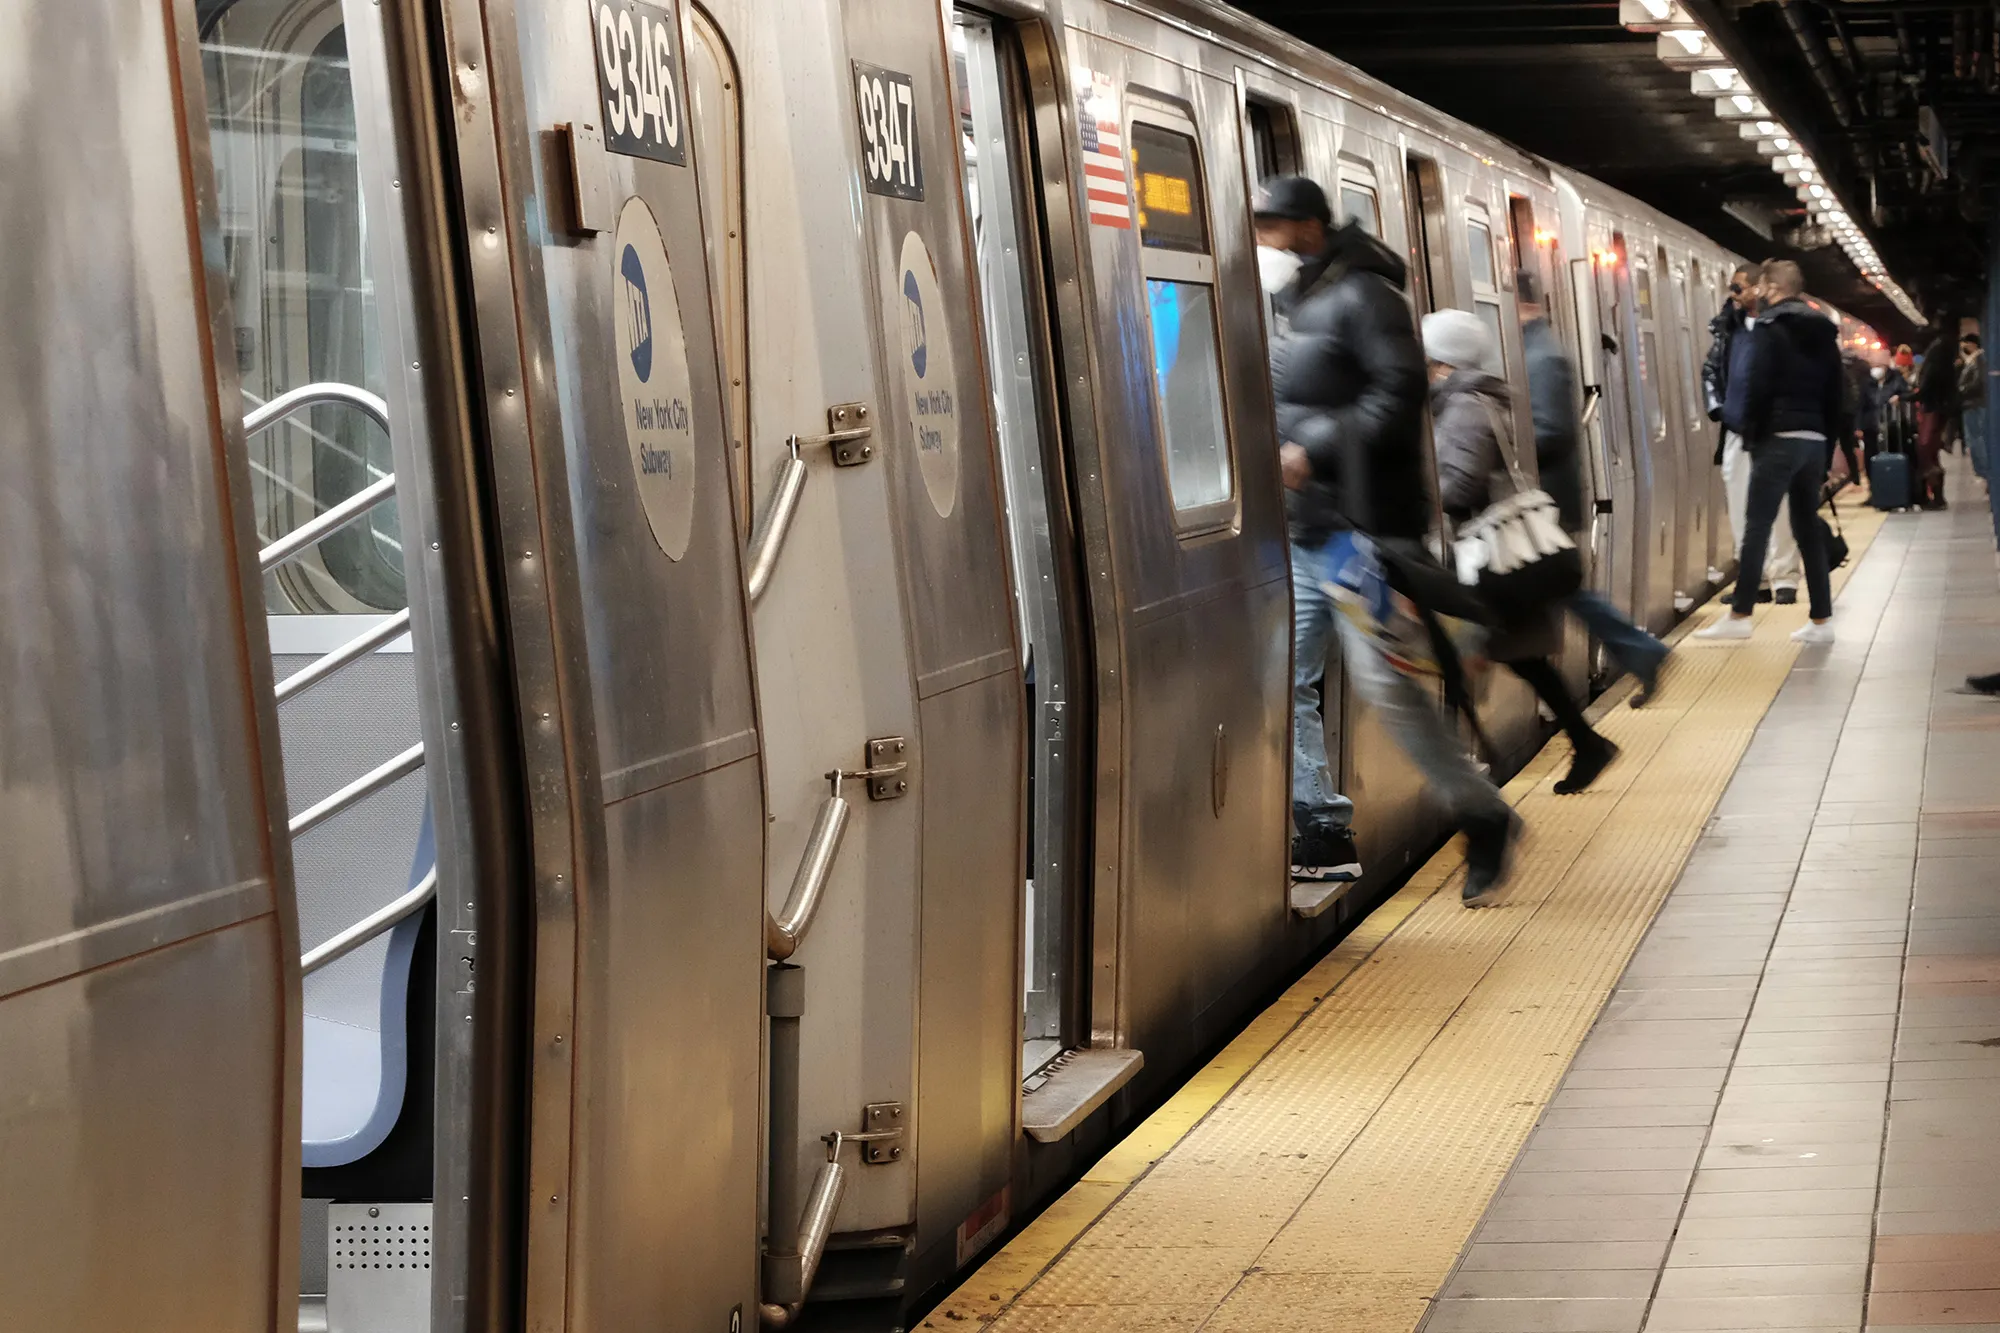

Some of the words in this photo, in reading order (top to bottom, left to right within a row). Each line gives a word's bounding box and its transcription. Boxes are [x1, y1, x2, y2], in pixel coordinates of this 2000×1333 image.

[600, 4, 679, 148] 9346
[858, 74, 917, 187] 9347
[635, 398, 653, 430] New
[653, 398, 673, 430] York
[673, 398, 689, 436] City
[915, 390, 928, 415] New
[928, 389, 941, 414] York
[941, 389, 953, 418] City
[919, 424, 942, 454] Subway
[641, 443, 671, 480] Subway
